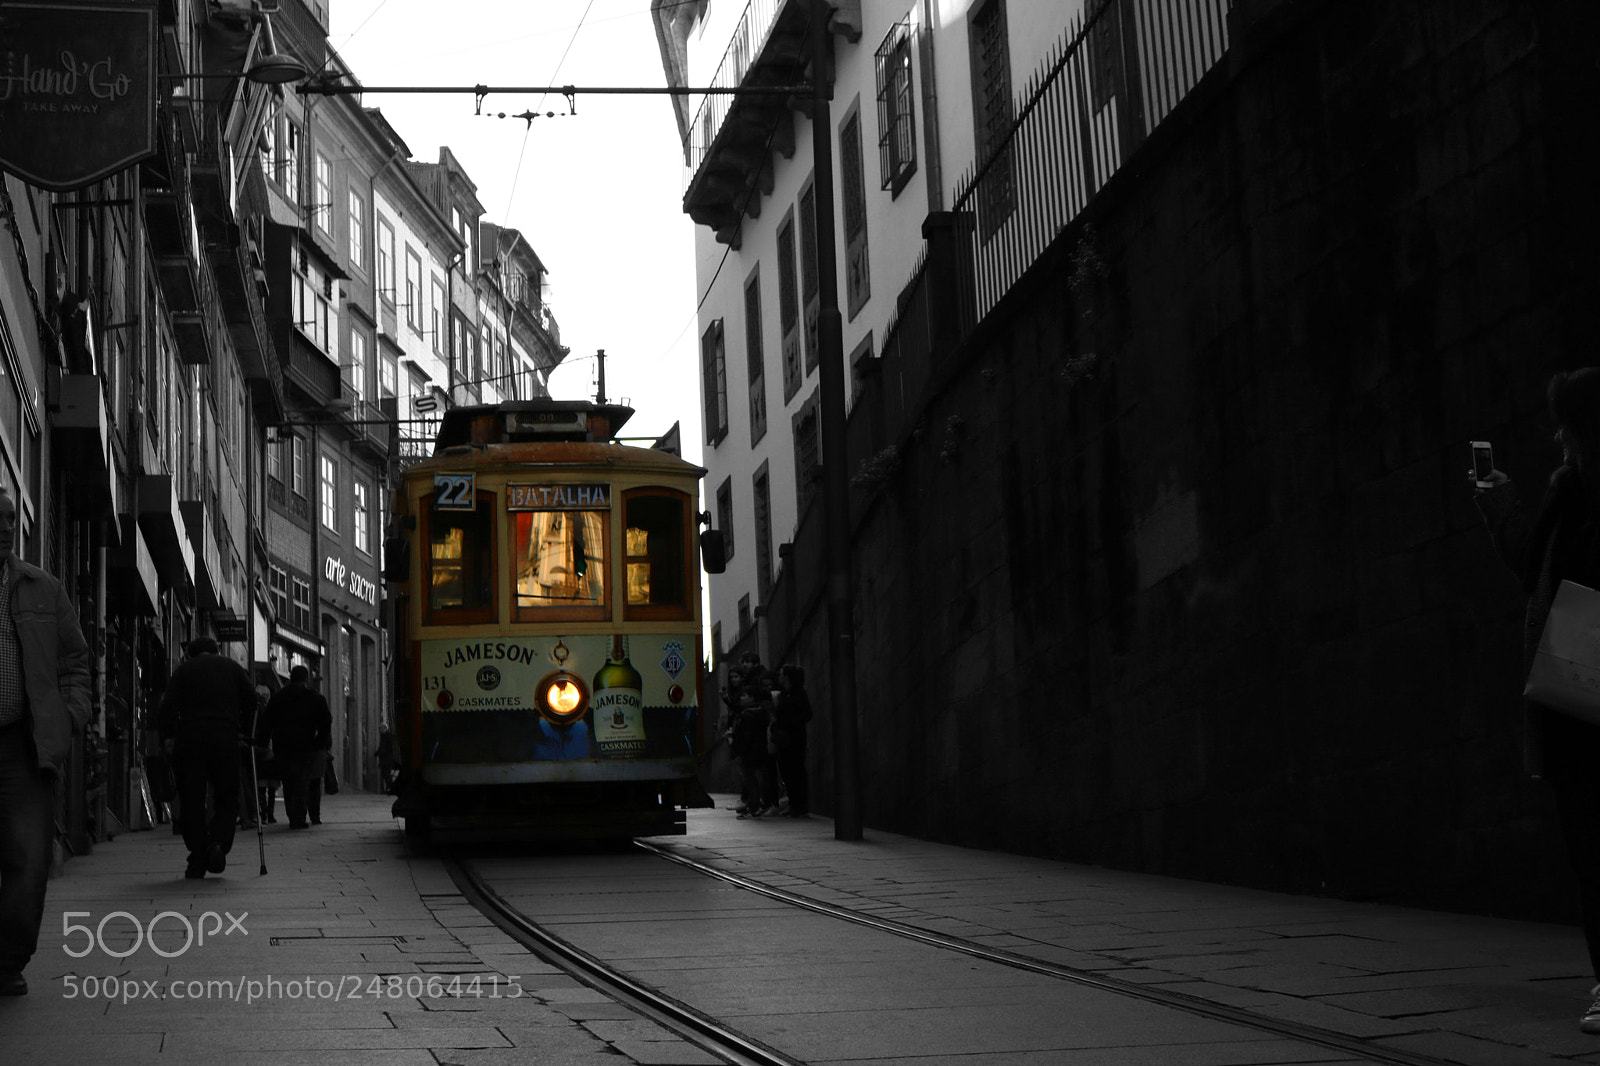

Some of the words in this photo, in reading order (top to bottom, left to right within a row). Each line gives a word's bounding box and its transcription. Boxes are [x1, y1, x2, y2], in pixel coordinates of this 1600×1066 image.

[23, 102, 57, 113] TAKE
[62, 103, 99, 115] AWAY
[436, 478, 470, 505] 22
[511, 486, 606, 506] BATALHA
[325, 555, 346, 588] arte
[349, 570, 376, 607] sacra
[444, 642, 535, 669] JAMESON
[423, 675, 447, 690] 131
[458, 696, 521, 707] CASKMATES
[595, 694, 640, 711] JAMESON
